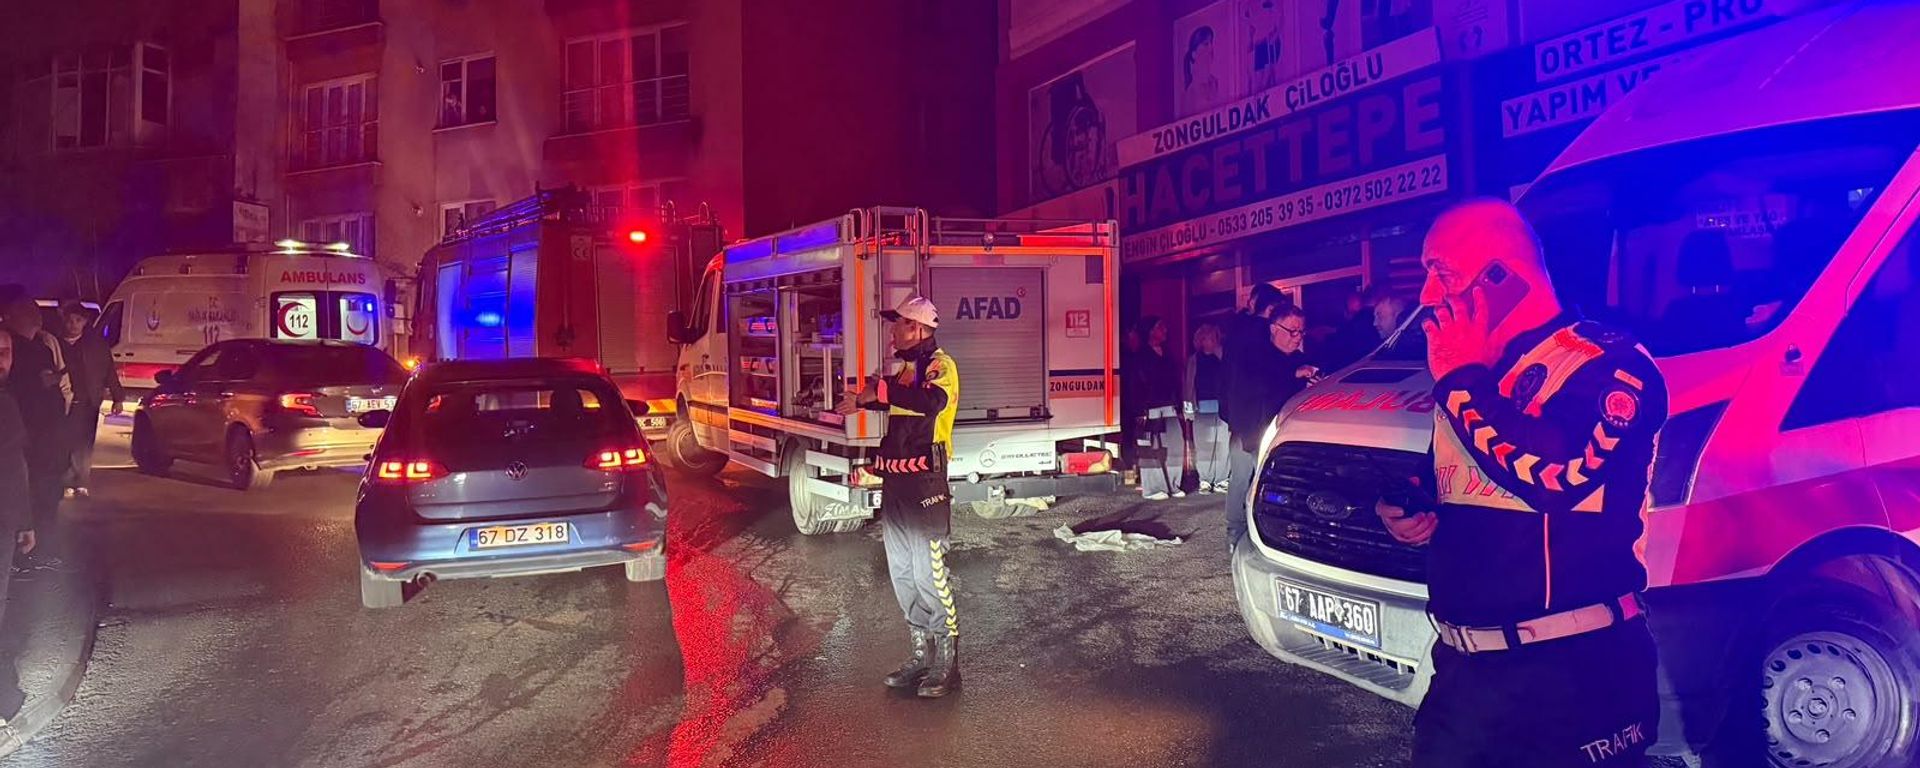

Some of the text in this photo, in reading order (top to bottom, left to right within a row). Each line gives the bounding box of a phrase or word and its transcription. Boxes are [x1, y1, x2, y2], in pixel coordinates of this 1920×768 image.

[1540, 17, 1649, 75] ORTEZ
[1505, 79, 1608, 130] YAPIM
[1152, 94, 1270, 154] ZONGULDAK
[1120, 75, 1446, 231] HACETTEPE
[1217, 214, 1248, 236] 0533
[1250, 206, 1273, 229] 205
[1278, 201, 1294, 221] 39
[1298, 195, 1314, 215] 35
[1364, 176, 1393, 200] 502
[1397, 169, 1416, 192] 22
[1421, 164, 1442, 187] 22
[280, 270, 366, 285] AMBULANS
[290, 314, 309, 328] 112
[955, 296, 1021, 320] AFAD
[1067, 312, 1088, 327] 112
[1050, 380, 1105, 392] ZONGULDAK
[479, 525, 565, 545] 67 DZ 318
[1285, 586, 1300, 613] 67
[1309, 592, 1334, 623] AAP
[1343, 602, 1374, 635] 360
